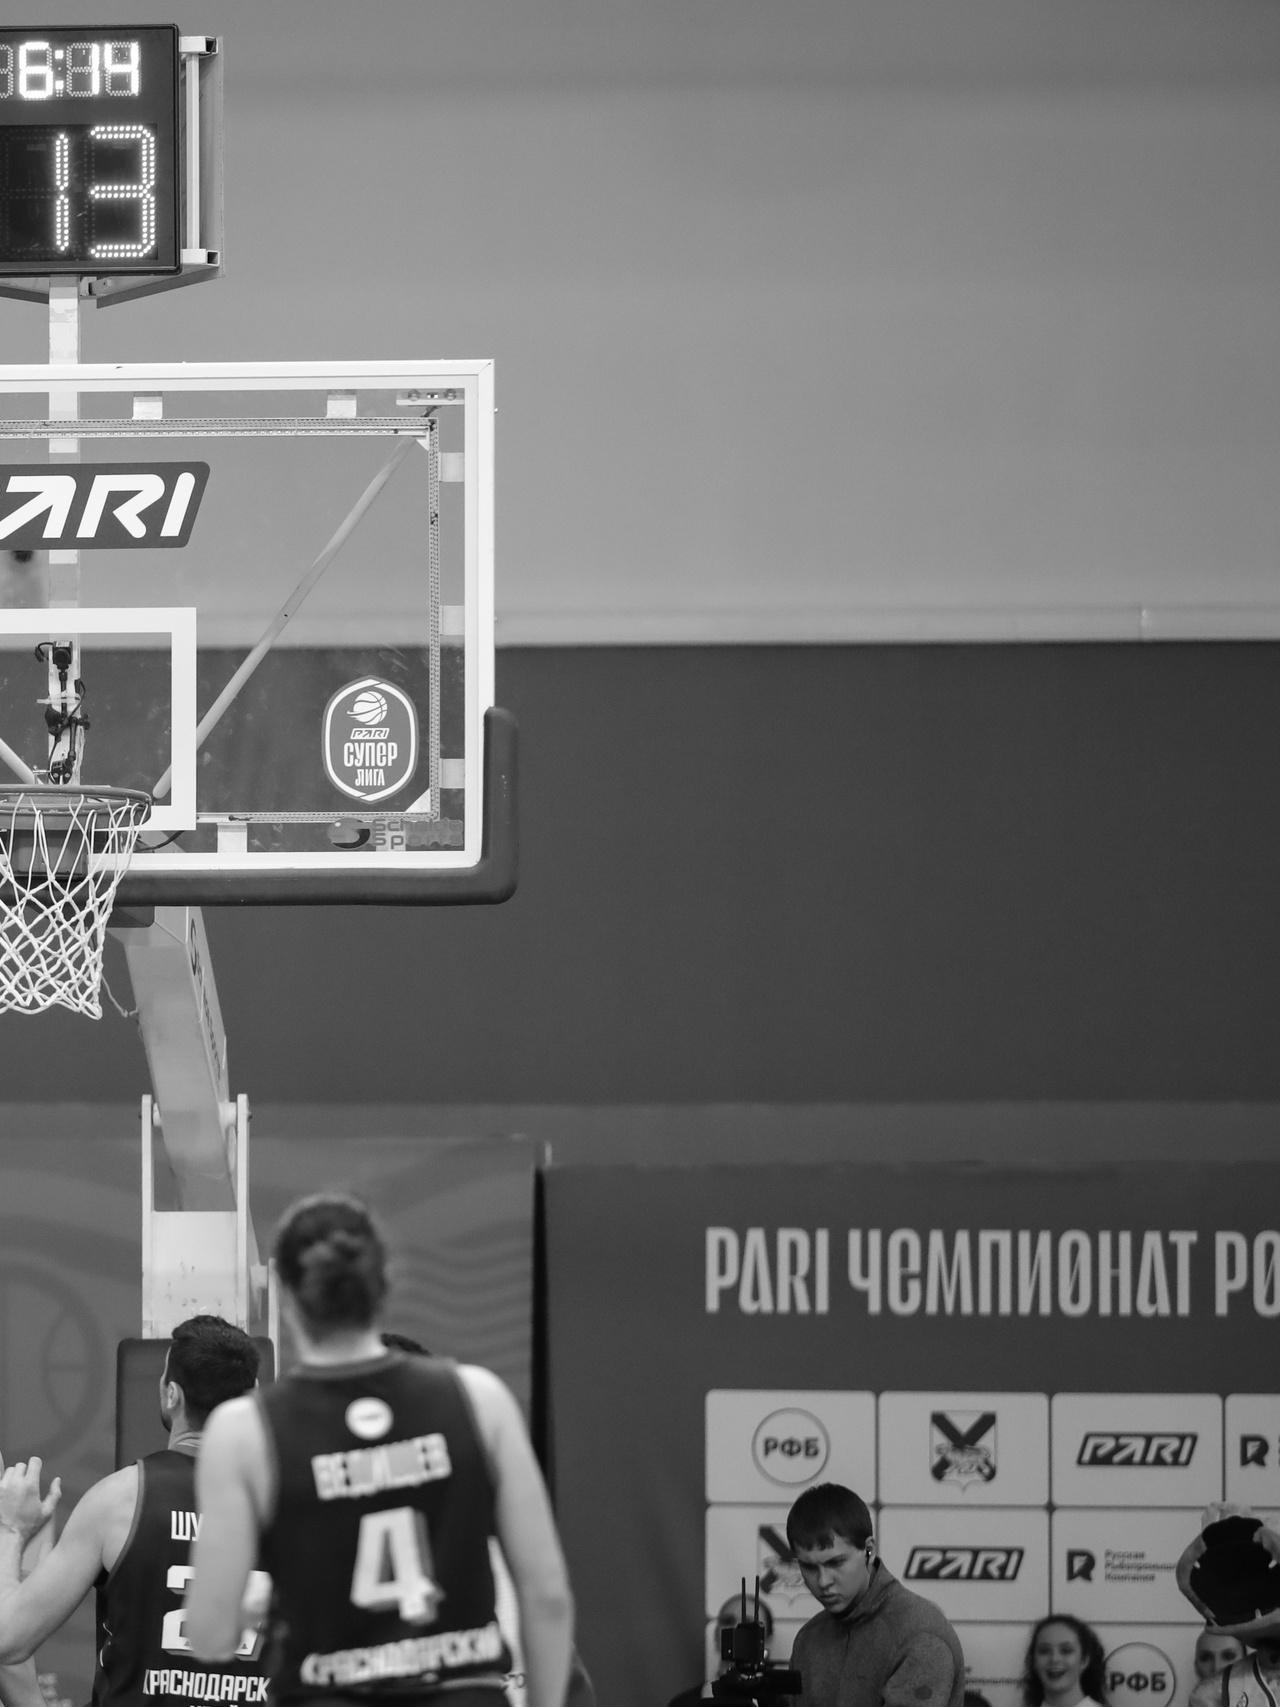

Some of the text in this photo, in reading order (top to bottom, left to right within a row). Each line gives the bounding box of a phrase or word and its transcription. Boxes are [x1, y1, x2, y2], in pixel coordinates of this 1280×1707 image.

[19, 41, 139, 100] 6:14
[54, 124, 156, 259] 13
[352, 729, 388, 738] PARI
[354, 769, 386, 786] ЛИГА
[705, 1226, 829, 1314] PARI
[763, 1436, 820, 1459] РФБ
[1081, 1436, 1193, 1464] PARI
[351, 1506, 436, 1624] 4
[907, 1550, 1020, 1578] PARI
[1109, 1671, 1166, 1693] РФБ
